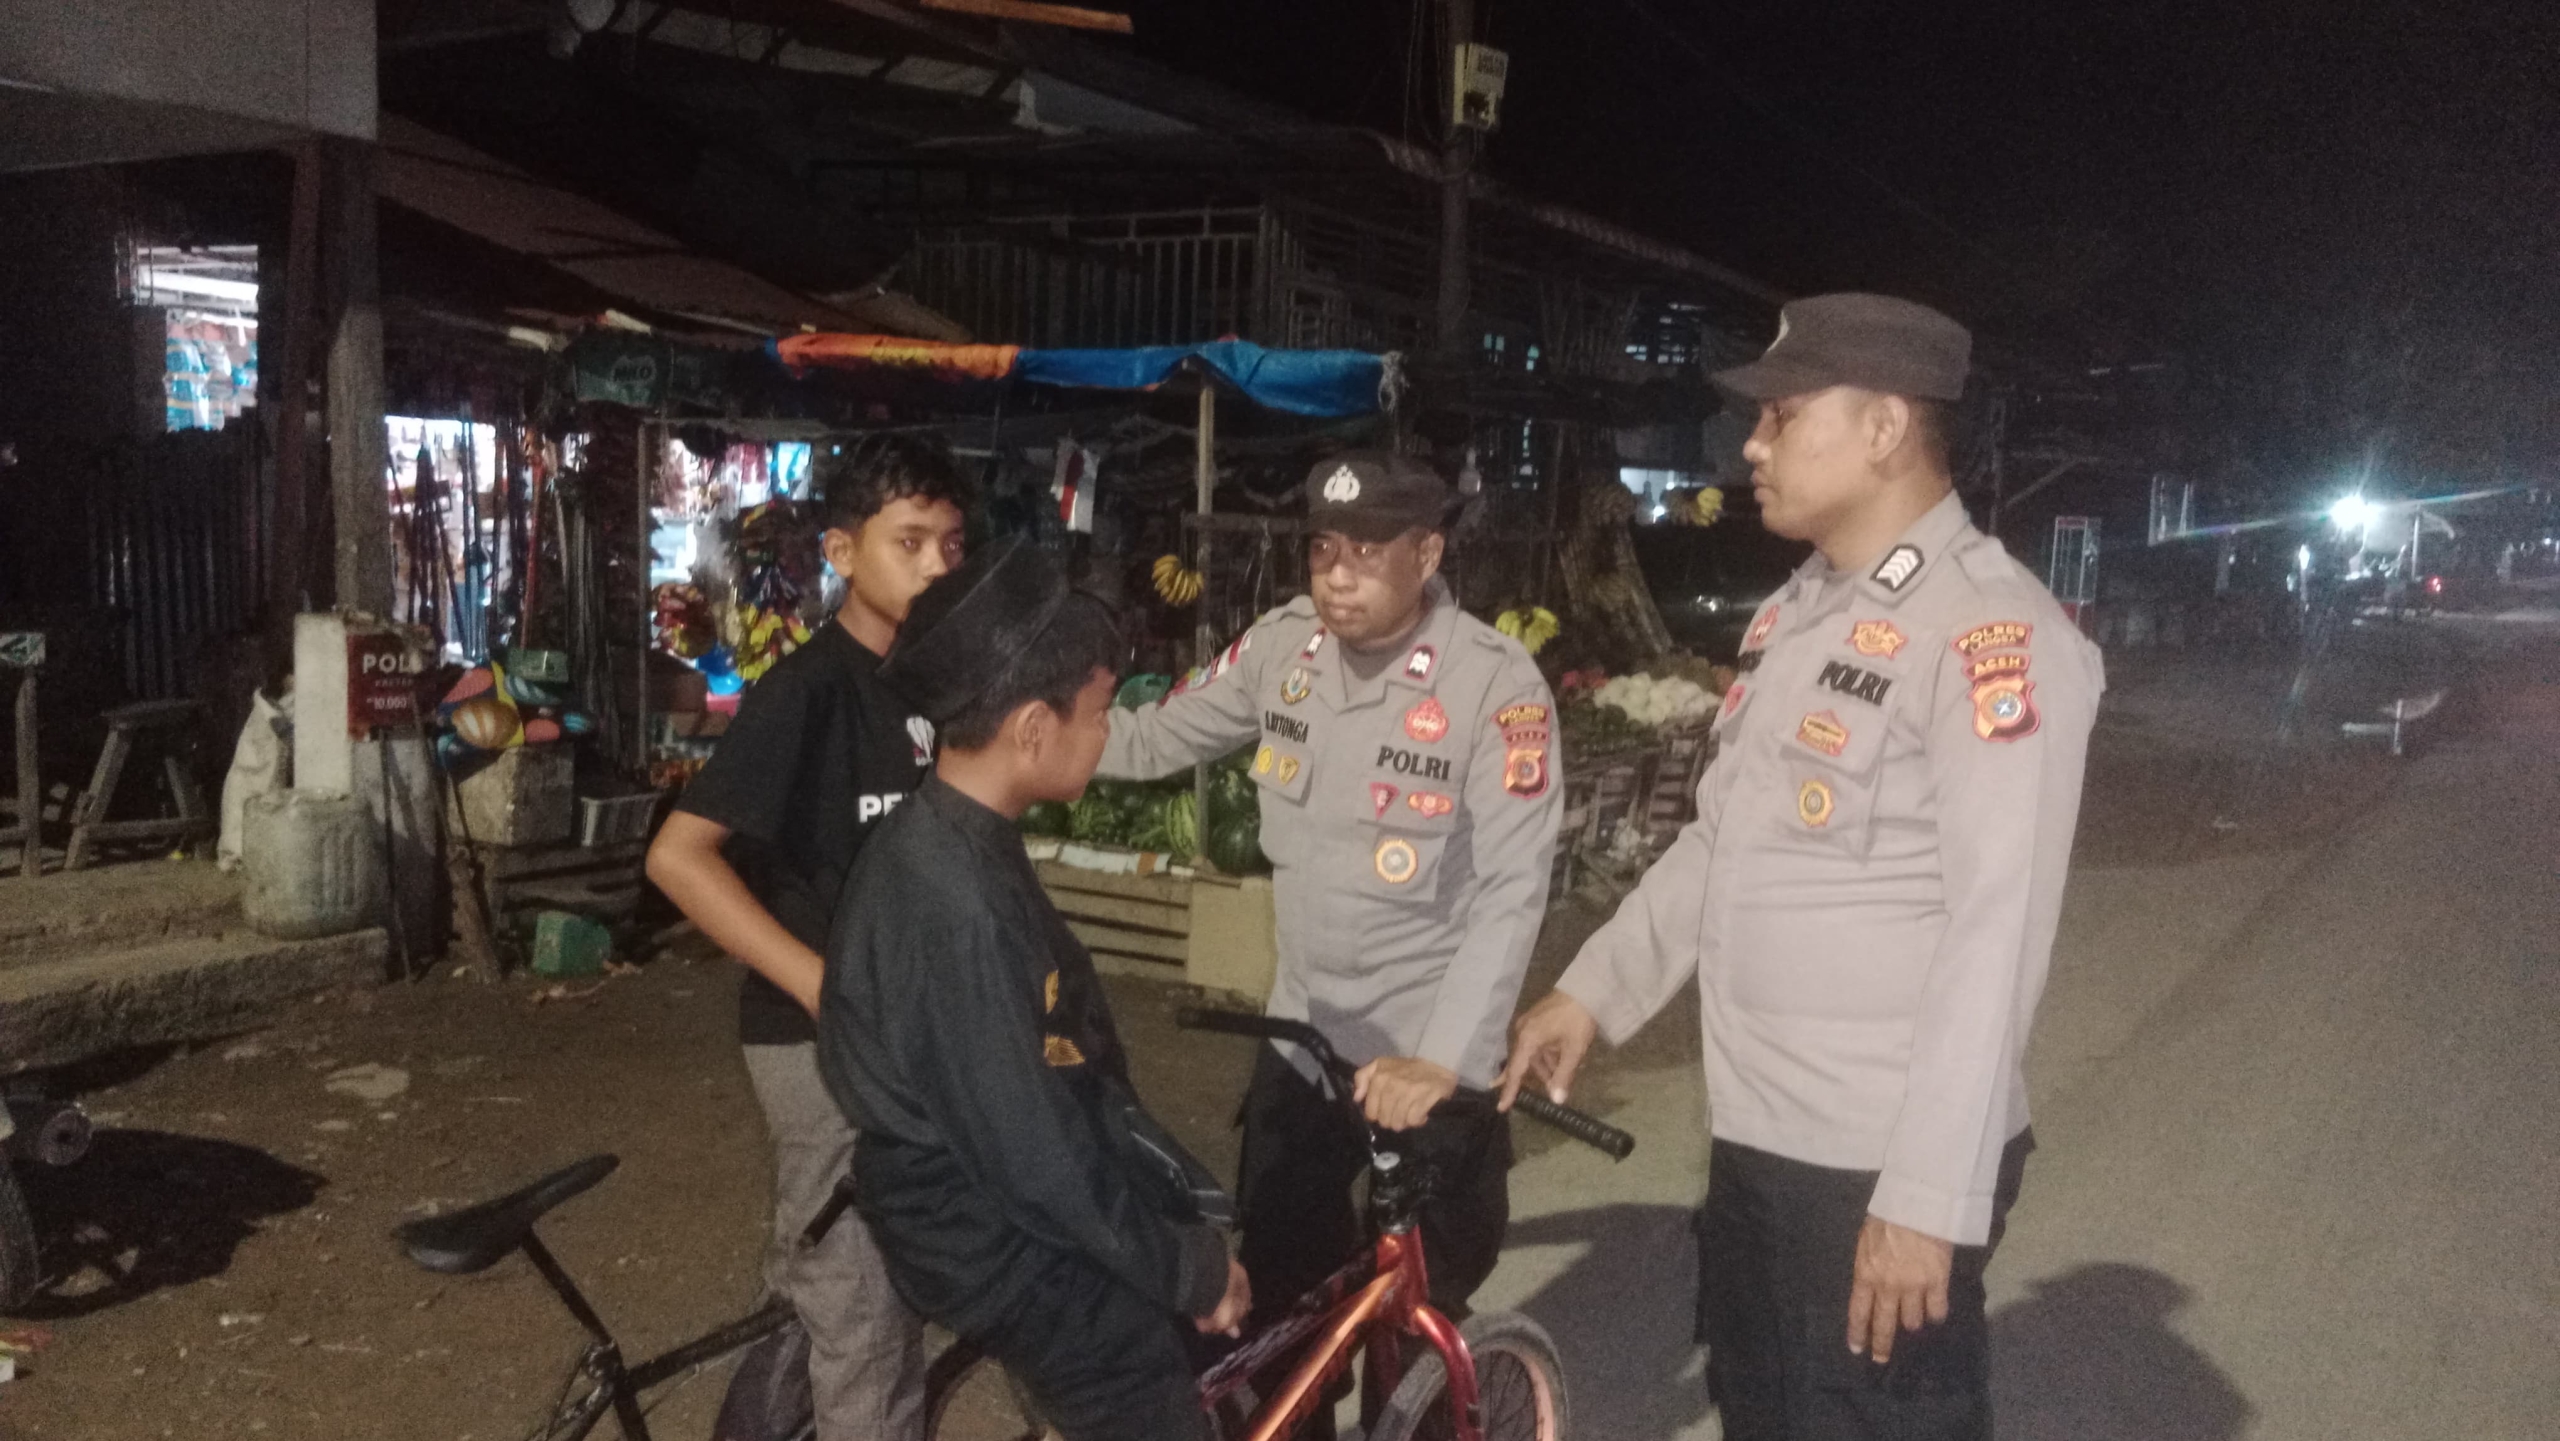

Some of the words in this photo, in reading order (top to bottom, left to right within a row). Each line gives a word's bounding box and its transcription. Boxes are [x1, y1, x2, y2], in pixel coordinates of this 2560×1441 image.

[1958, 625, 2025, 650] POLRES
[1974, 656, 2020, 675] ACEH
[1817, 660, 1892, 706] POLRI
[1376, 745, 1452, 781] POLRI
